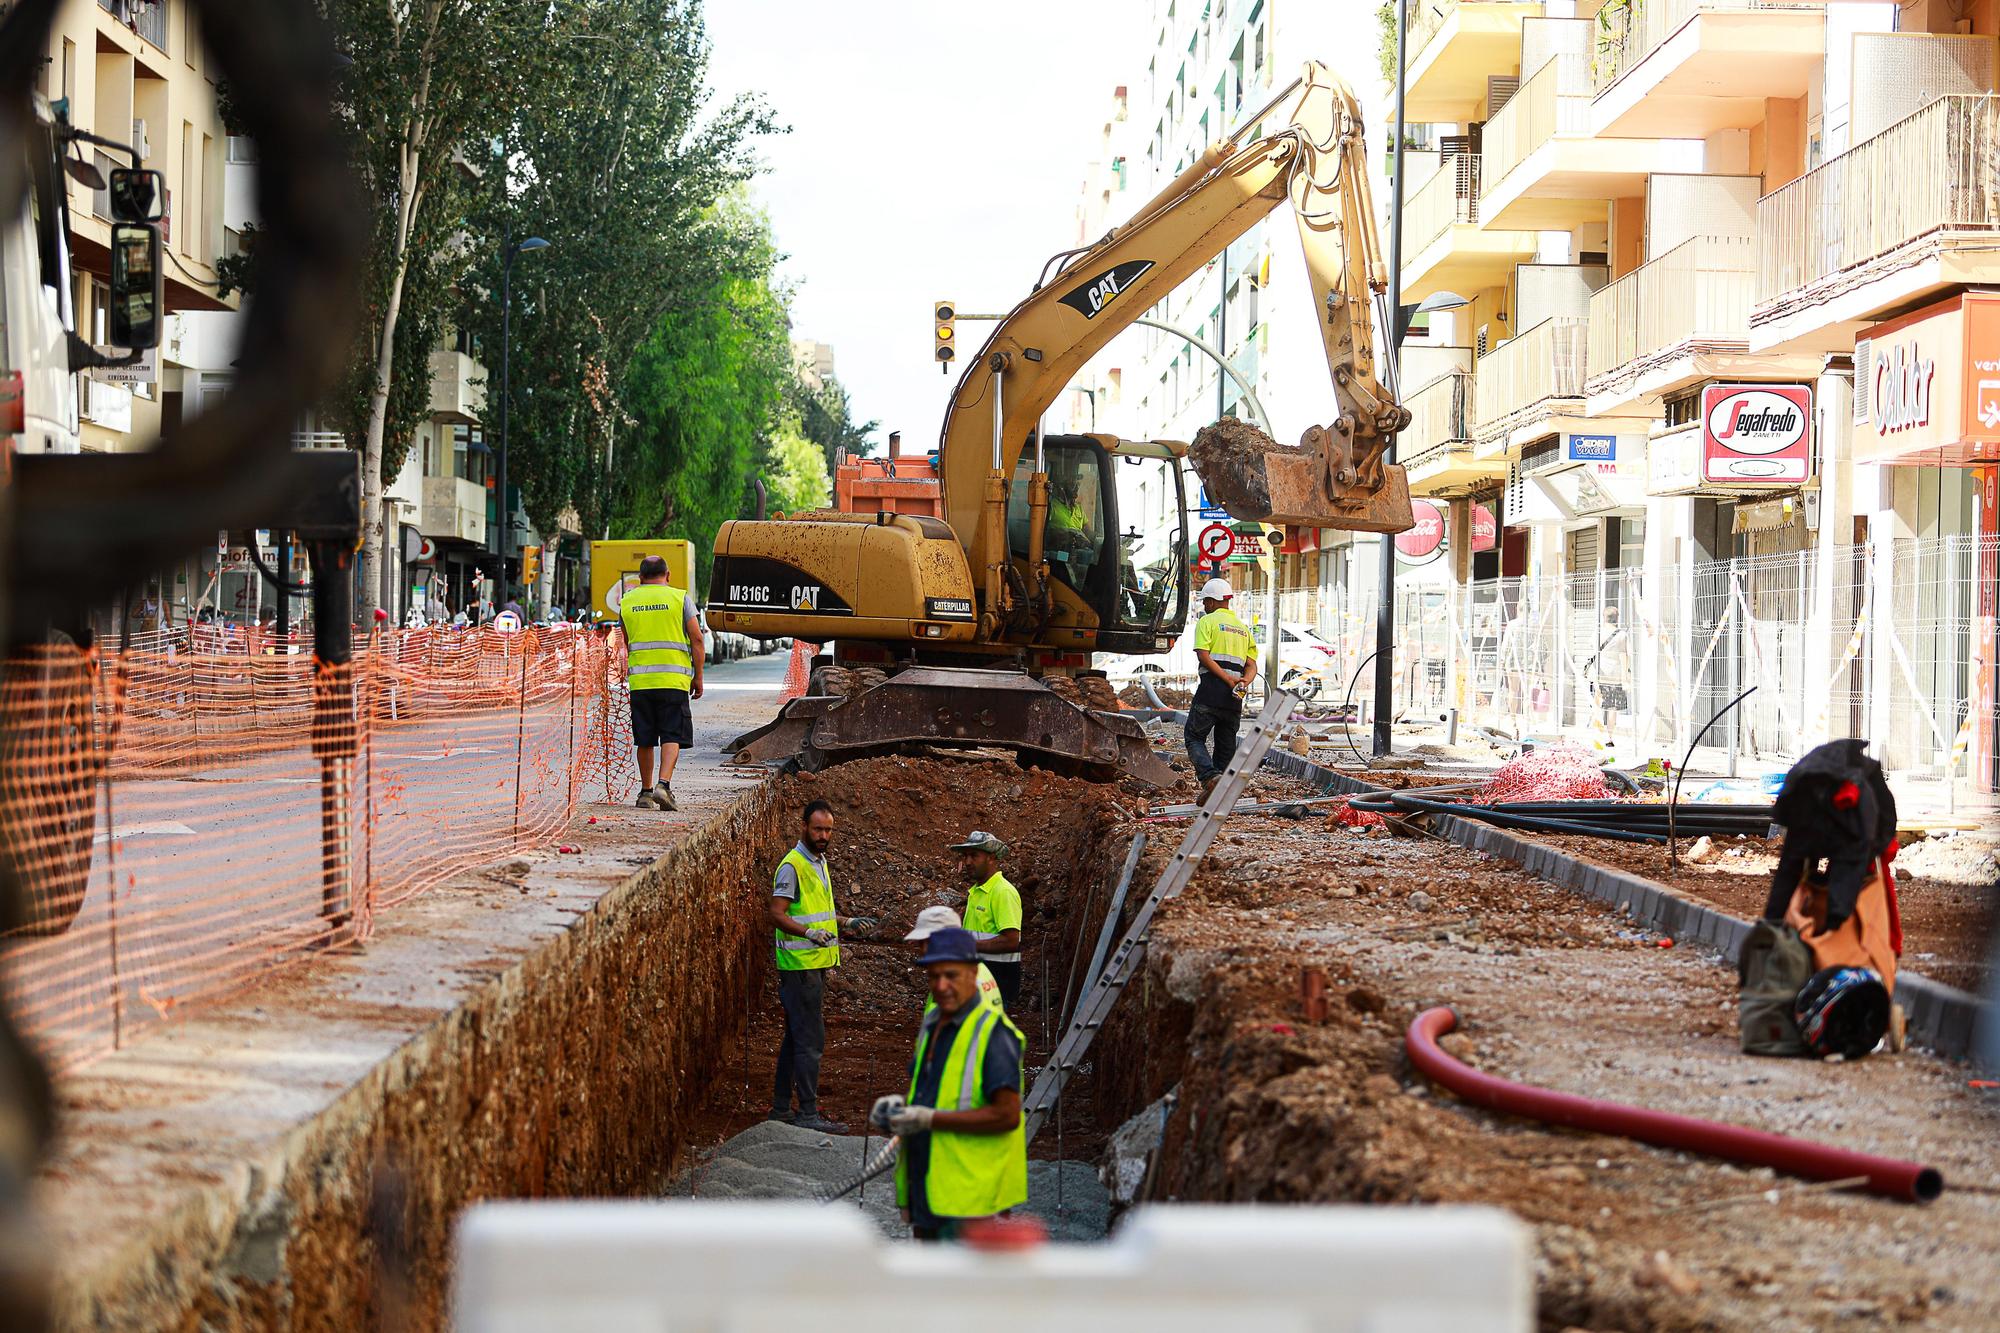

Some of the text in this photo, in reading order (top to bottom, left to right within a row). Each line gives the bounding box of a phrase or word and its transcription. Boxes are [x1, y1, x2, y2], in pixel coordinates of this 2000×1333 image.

[1088, 270, 1120, 311] CAT
[1718, 400, 1797, 439] Segafredo
[1583, 439, 1610, 447] EDEN
[1234, 535, 1258, 545] BAZ
[1232, 544, 1264, 554] ENT
[791, 585, 820, 611] CAT
[645, 603, 669, 611] BARREDA
[933, 600, 970, 612] CATERPILLAR
